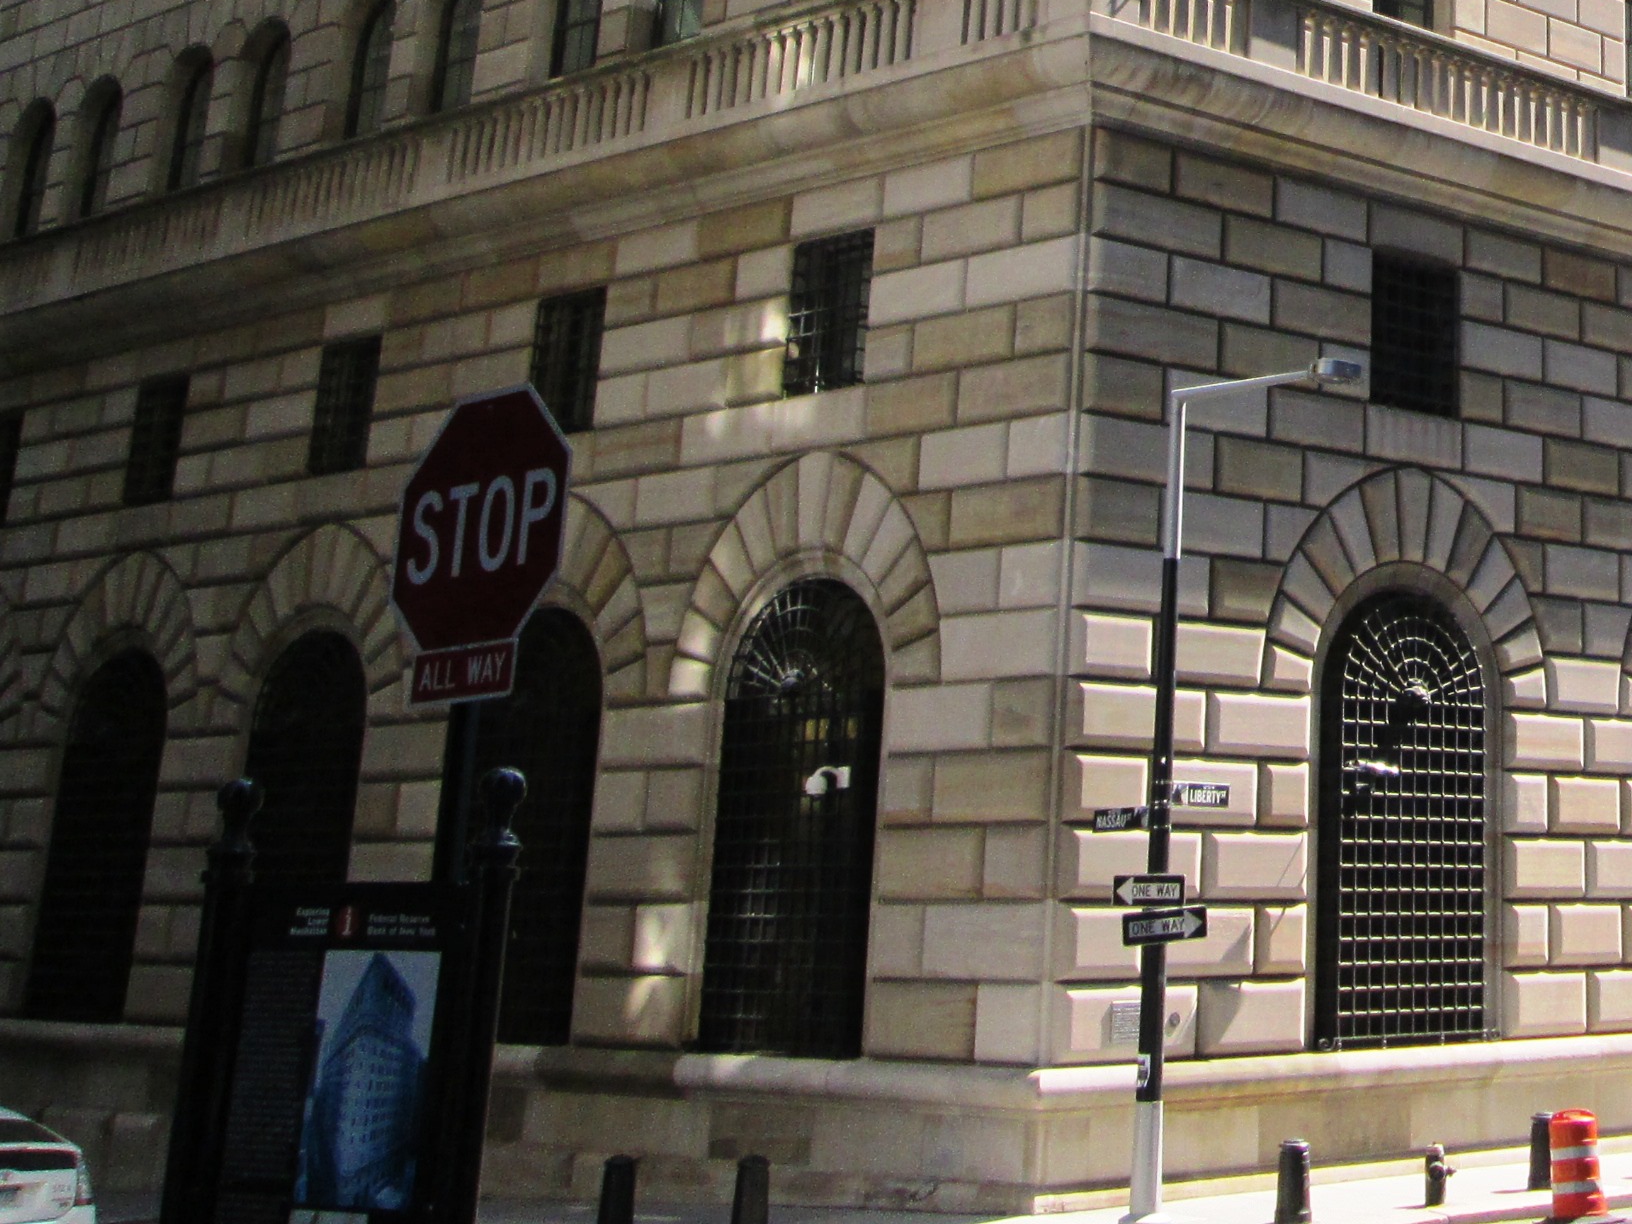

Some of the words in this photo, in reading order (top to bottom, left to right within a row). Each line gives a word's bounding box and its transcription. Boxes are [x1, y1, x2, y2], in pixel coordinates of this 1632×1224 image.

[406, 467, 557, 585] STOP
[419, 659, 455, 692] ALL
[467, 651, 507, 686] WAY
[1190, 789, 1221, 804] LIBERTY
[1096, 815, 1126, 828] NASSAU
[1132, 886, 1150, 897] ONE
[1157, 884, 1178, 896] WAY
[1132, 923, 1155, 936] ONE
[1162, 919, 1184, 932] WAY
